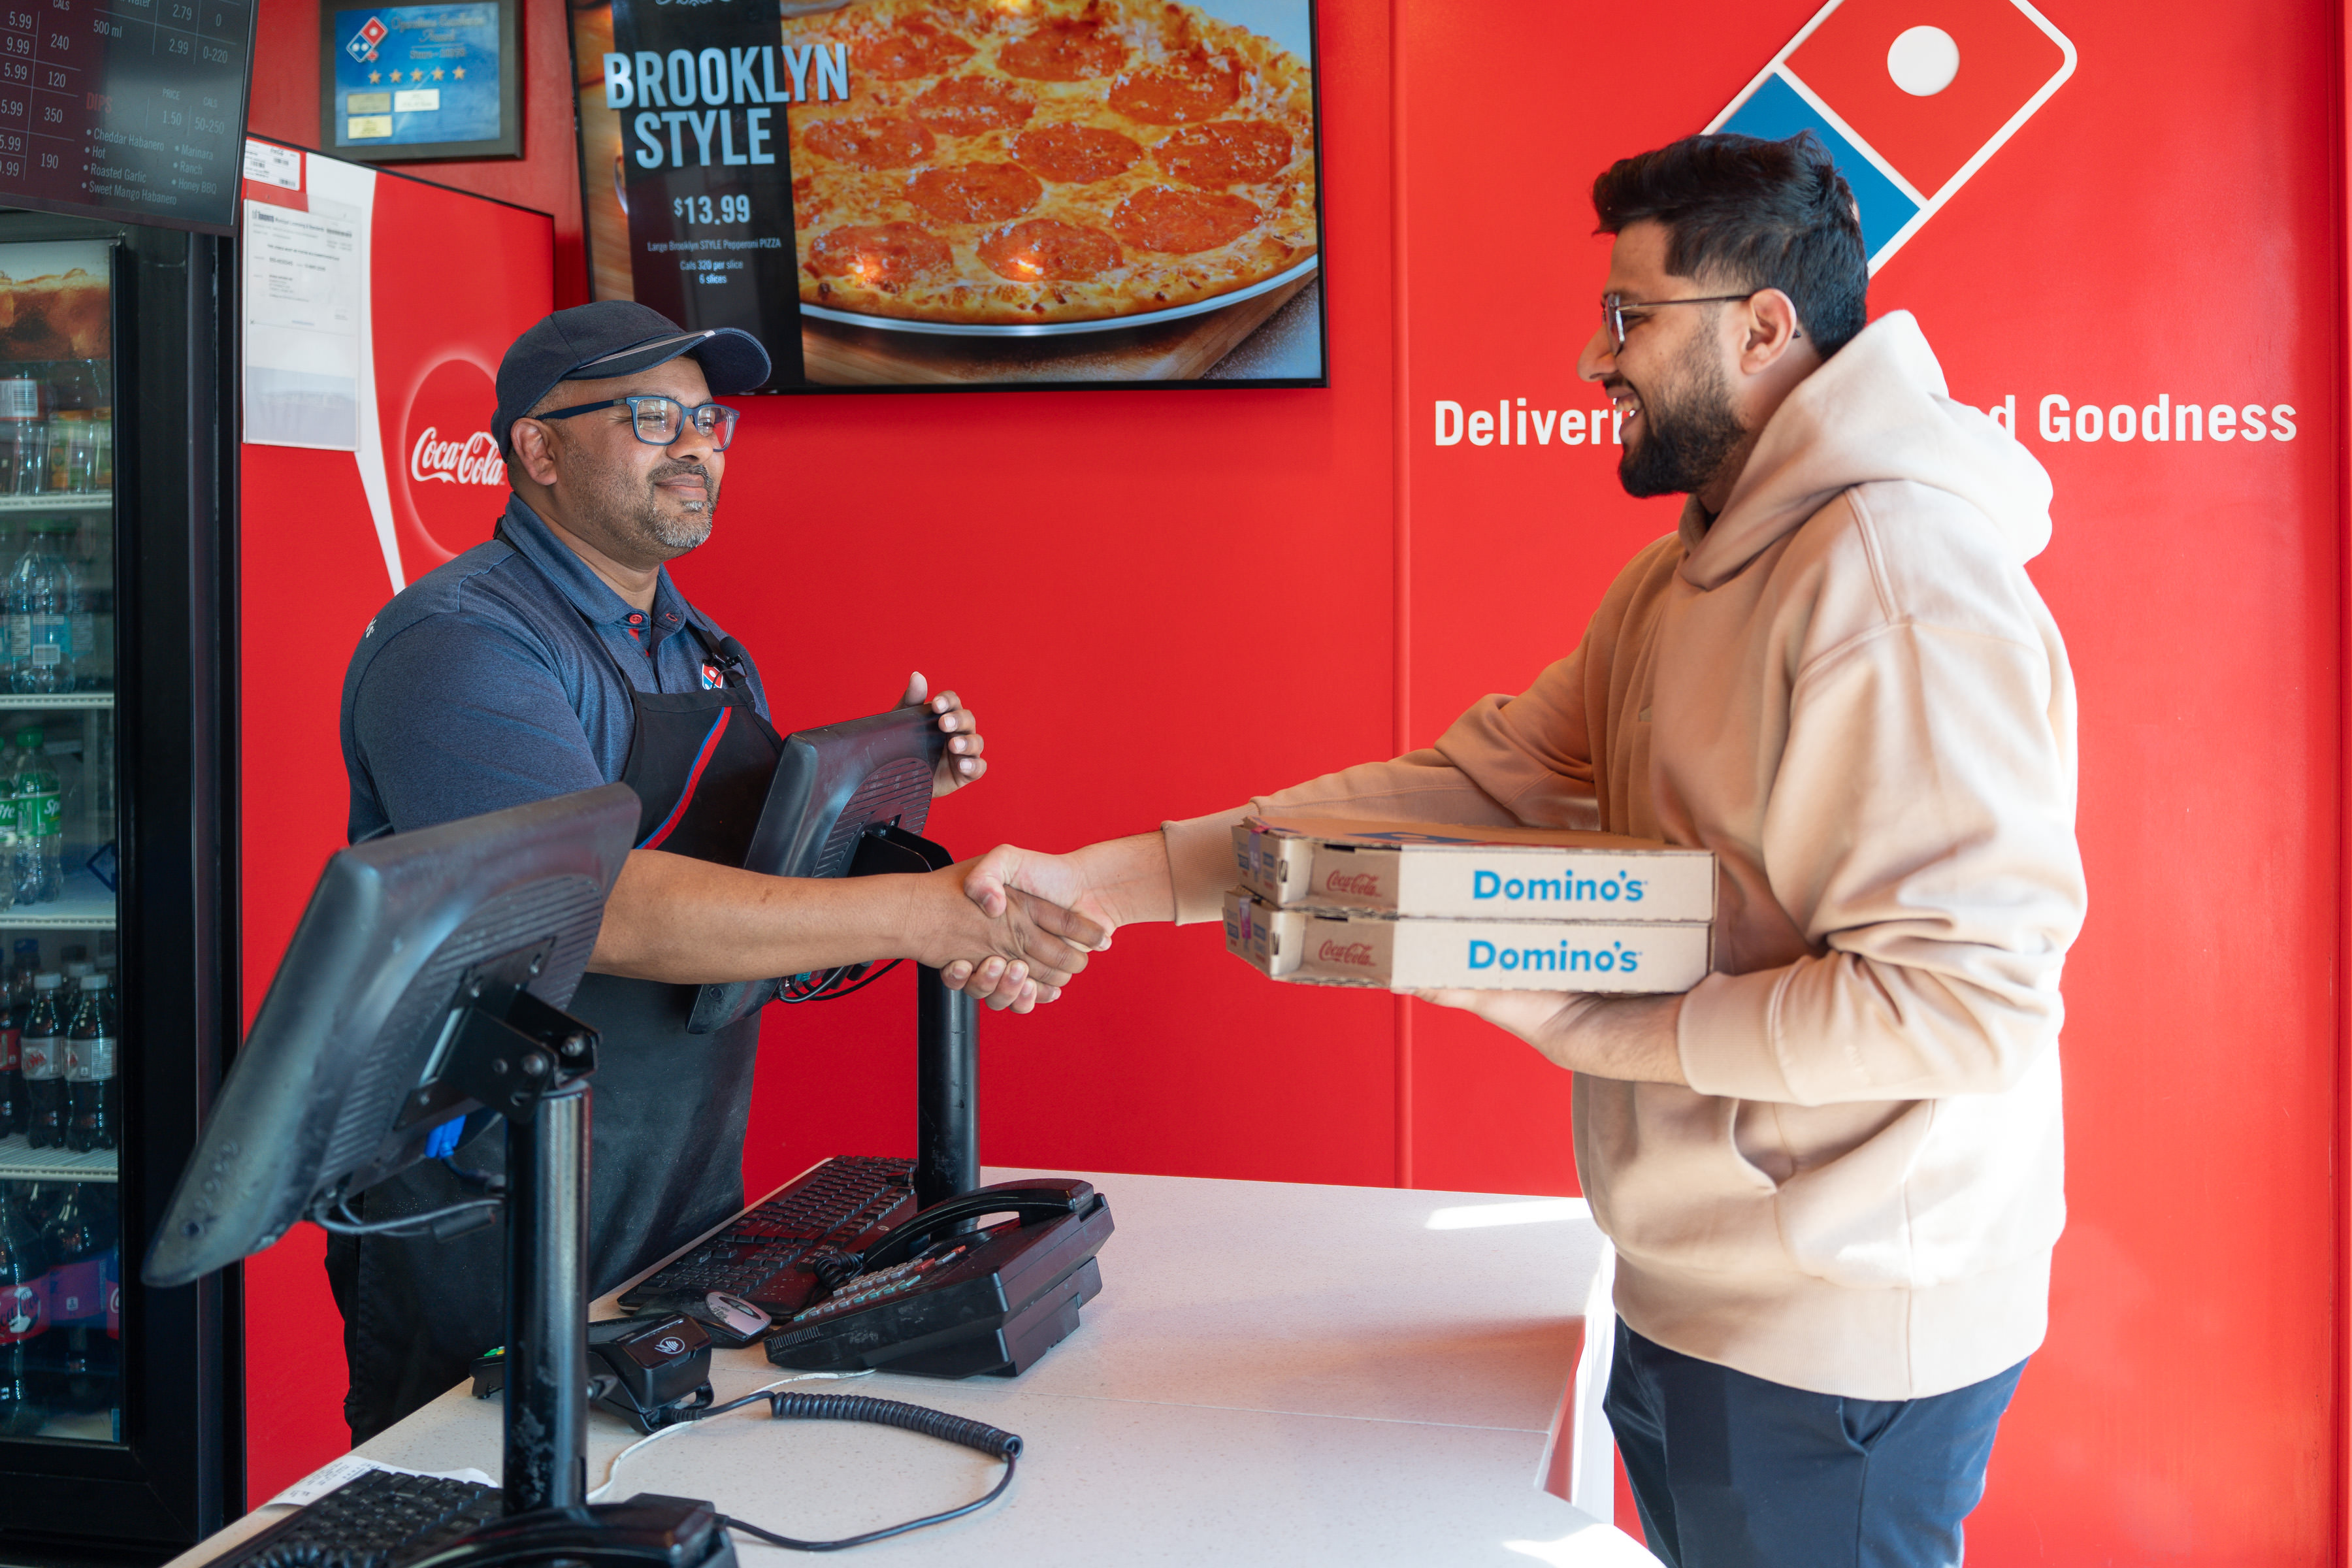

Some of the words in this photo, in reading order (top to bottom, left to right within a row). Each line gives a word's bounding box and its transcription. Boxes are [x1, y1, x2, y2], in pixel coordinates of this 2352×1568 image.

[53, 0, 70, 10] CALS
[172, 4, 191, 21] 2.79
[9, 11, 31, 29] 5.99
[216, 14, 221, 27] 0
[93, 20, 109, 35] 500
[112, 25, 122, 39] ml
[7, 37, 29, 54] 9.99
[51, 33, 69, 50] 240
[169, 38, 188, 55] 2.99
[203, 46, 227, 64] 0-220
[5, 63, 27, 80] 5.99
[48, 71, 66, 88] 120
[604, 43, 849, 108] BROOKLYN
[86, 92, 112, 114] DIPS
[162, 88, 180, 101] PRICE
[203, 97, 218, 108] CALS
[1, 99, 23, 116] 5.99
[44, 106, 63, 123] 350
[163, 110, 182, 125] 1.50
[195, 116, 224, 135] 50-250
[93, 127, 127, 145] Cheddar
[129, 133, 165, 152] Habanero
[634, 108, 776, 169] STYLE
[41, 153, 59, 169] 190
[92, 146, 106, 159] Hot
[181, 144, 213, 161] Marinara
[91, 163, 122, 179] Roasted
[124, 169, 146, 184] Garlic
[180, 161, 203, 175] Ranch
[89, 180, 112, 195] Sweet
[114, 184, 140, 201] Mango
[142, 189, 176, 205] Habanero
[178, 177, 200, 193] Honey
[201, 181, 217, 195] BBQ
[674, 194, 751, 225] $13.99
[647, 242, 667, 253] Large
[669, 240, 698, 253] Brooklyn
[700, 239, 722, 250] STYLE
[723, 238, 758, 252] Pepperoni
[759, 237, 781, 248] PIZZA
[679, 260, 696, 270] Cals
[698, 259, 712, 270] 320
[713, 261, 725, 271] per
[727, 259, 743, 269] slice
[699, 274, 705, 284] 6
[706, 273, 727, 284] slices
[1435, 397, 1623, 446] Deliveri
[2039, 393, 2297, 442] Goodness
[411, 427, 504, 485] Coca-Cola
[1326, 870, 1380, 897] Coca-Cola
[1473, 870, 1644, 902] Domino's
[1318, 939, 1373, 966] Coca-Cola
[1468, 939, 1638, 973] Domino's
